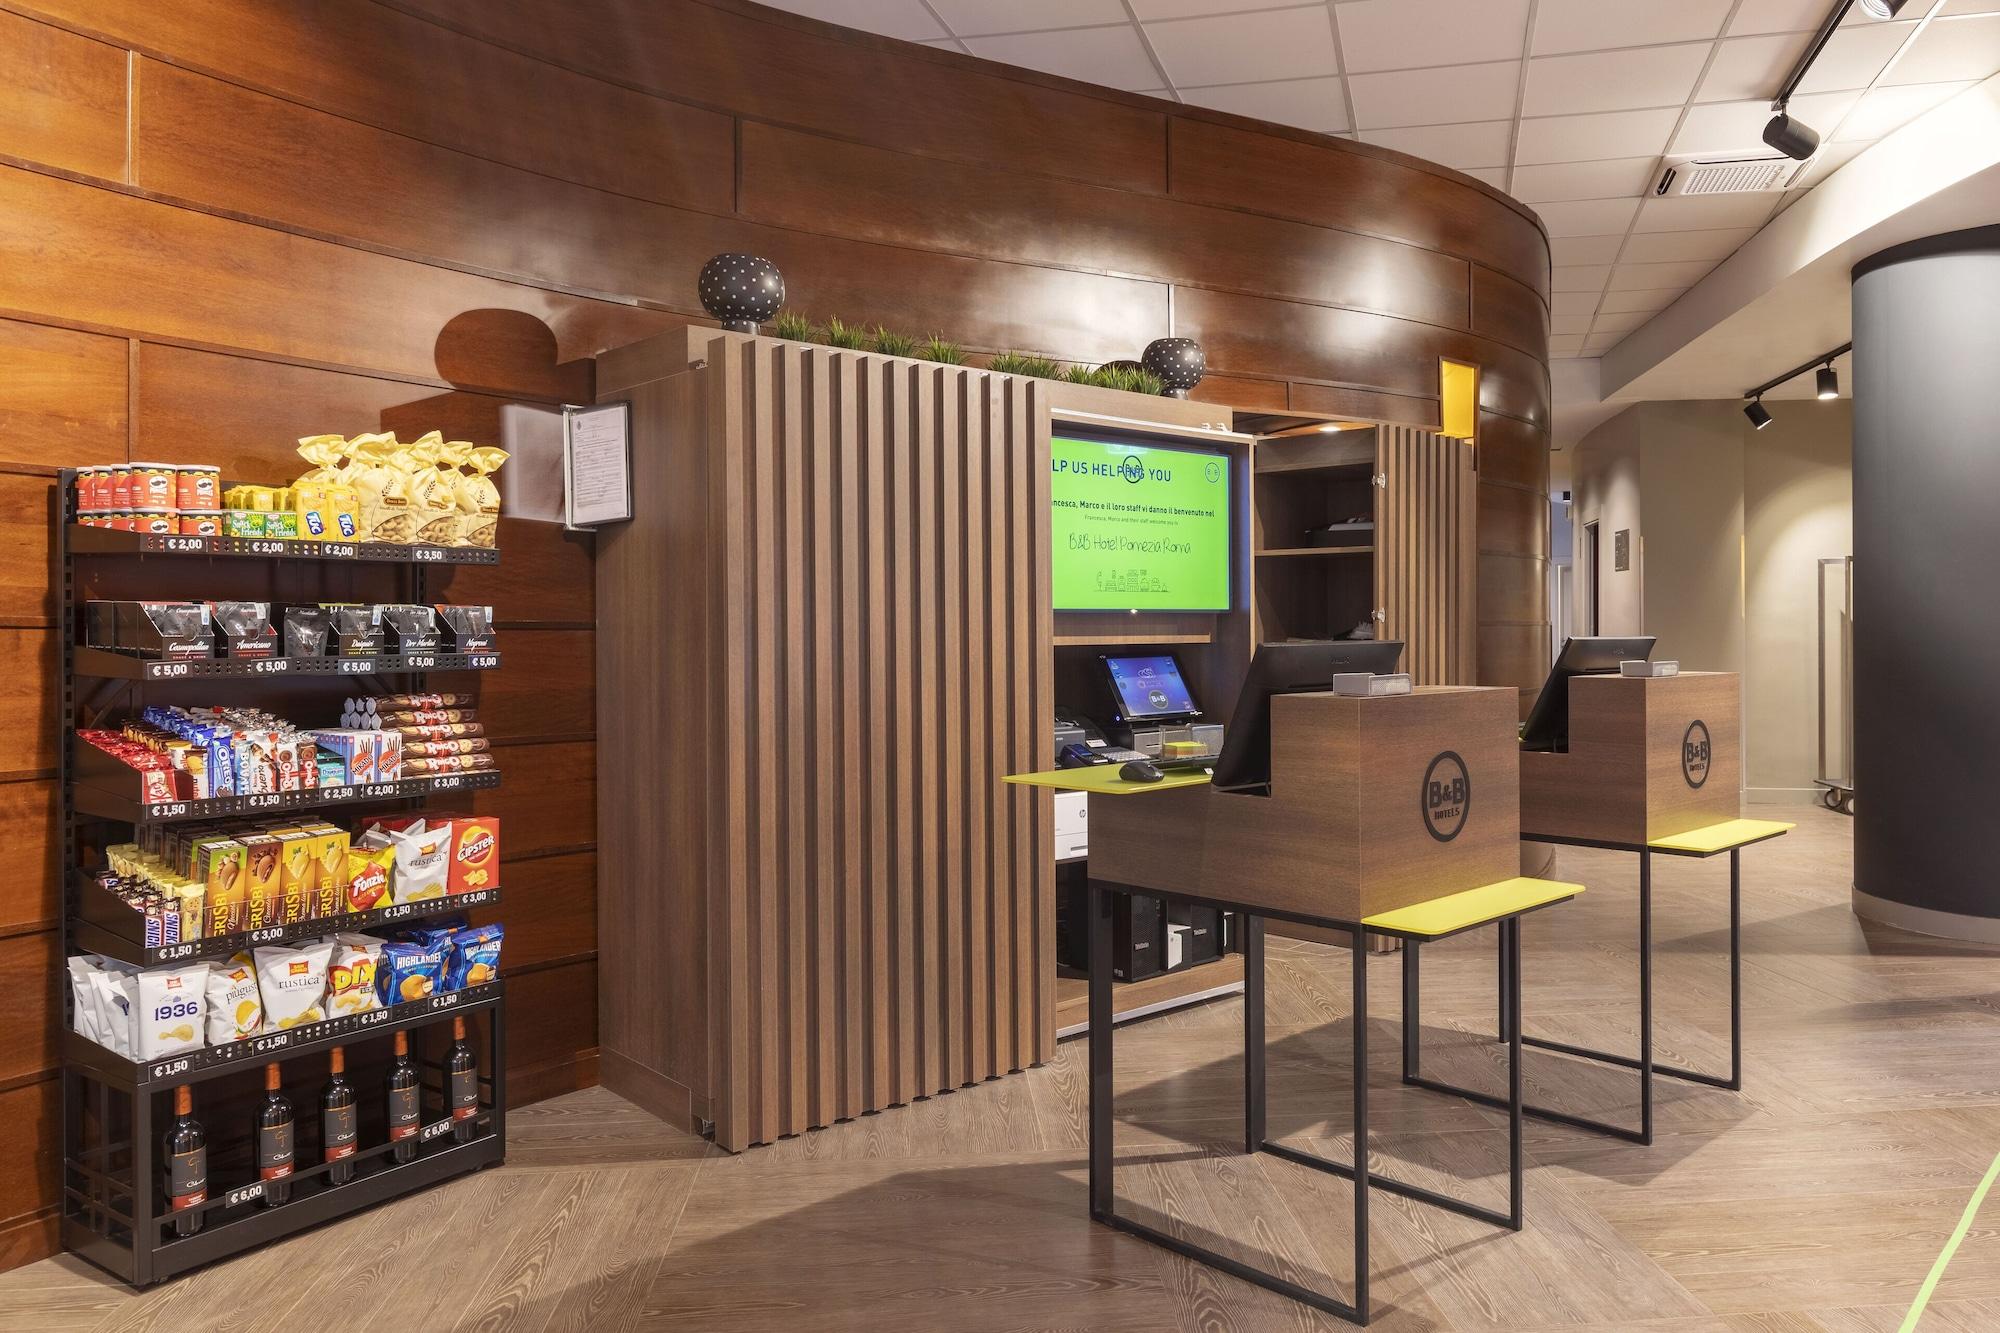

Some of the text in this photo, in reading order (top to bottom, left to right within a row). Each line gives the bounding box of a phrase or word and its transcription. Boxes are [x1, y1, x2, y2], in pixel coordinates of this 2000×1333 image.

[1052, 458, 1068, 473] LP
[1072, 461, 1088, 475] US
[1149, 468, 1171, 482] YOU
[1052, 500, 1079, 509] ncesca,
[1080, 501, 1100, 510] Marco
[1106, 502, 1111, 510] il
[1112, 503, 1126, 512] loro
[1126, 504, 1142, 512] staff
[1142, 505, 1148, 513] vi
[1149, 506, 1168, 514] danno
[1174, 507, 1204, 516] benvenuto
[1206, 510, 1215, 518] nel
[306, 511, 322, 535] TUC
[339, 514, 354, 537] TUC
[168, 538, 202, 552] € 2,00
[252, 542, 284, 554] € 2,00
[324, 544, 354, 556] € 2,00
[1069, 532, 1192, 554] B&B Hotel Pomezia Roma
[416, 550, 442, 562] € 3,50
[236, 639, 272, 650] Americano
[256, 661, 287, 673] € 5,00
[343, 662, 371, 673] € 5,00
[408, 656, 434, 668] € 5,00
[472, 656, 496, 668] € 5,00
[153, 664, 188, 678] € 5,00
[1687, 740, 1708, 762] B&B
[218, 744, 232, 784] OREO
[352, 754, 374, 775] MIKADO
[378, 753, 401, 774] MIKADO
[240, 752, 250, 795] BOUNT
[366, 784, 394, 796] € 2,00
[434, 778, 460, 788] € 3,00
[324, 788, 353, 800] € 2,50
[1430, 778, 1465, 808] B&B
[250, 795, 280, 806] € 1,50
[152, 804, 186, 817] € 1,50
[1434, 808, 1460, 820] HOTELS
[457, 835, 495, 862] CIPSTER
[410, 854, 443, 867] rustica
[352, 874, 385, 897] Fonzie
[462, 892, 486, 904] € 3,00
[384, 906, 410, 918] € 1,50
[147, 918, 160, 948] SNICK
[165, 912, 180, 944] SNICK
[252, 928, 282, 942] € 3,00
[158, 944, 192, 960] € 1,50
[278, 976, 320, 989] rustica
[334, 961, 378, 991] DIX
[226, 982, 257, 1004] piùgust
[432, 994, 458, 1008] € 1,50
[154, 1001, 198, 1020] 1936
[361, 1010, 388, 1024] € 1,50
[256, 1035, 288, 1050] € 1,50
[154, 1060, 188, 1078] € 1,50
[424, 1128, 431, 1138] €
[432, 1121, 450, 1136] 6,00
[230, 1186, 262, 1204] € 6,00
